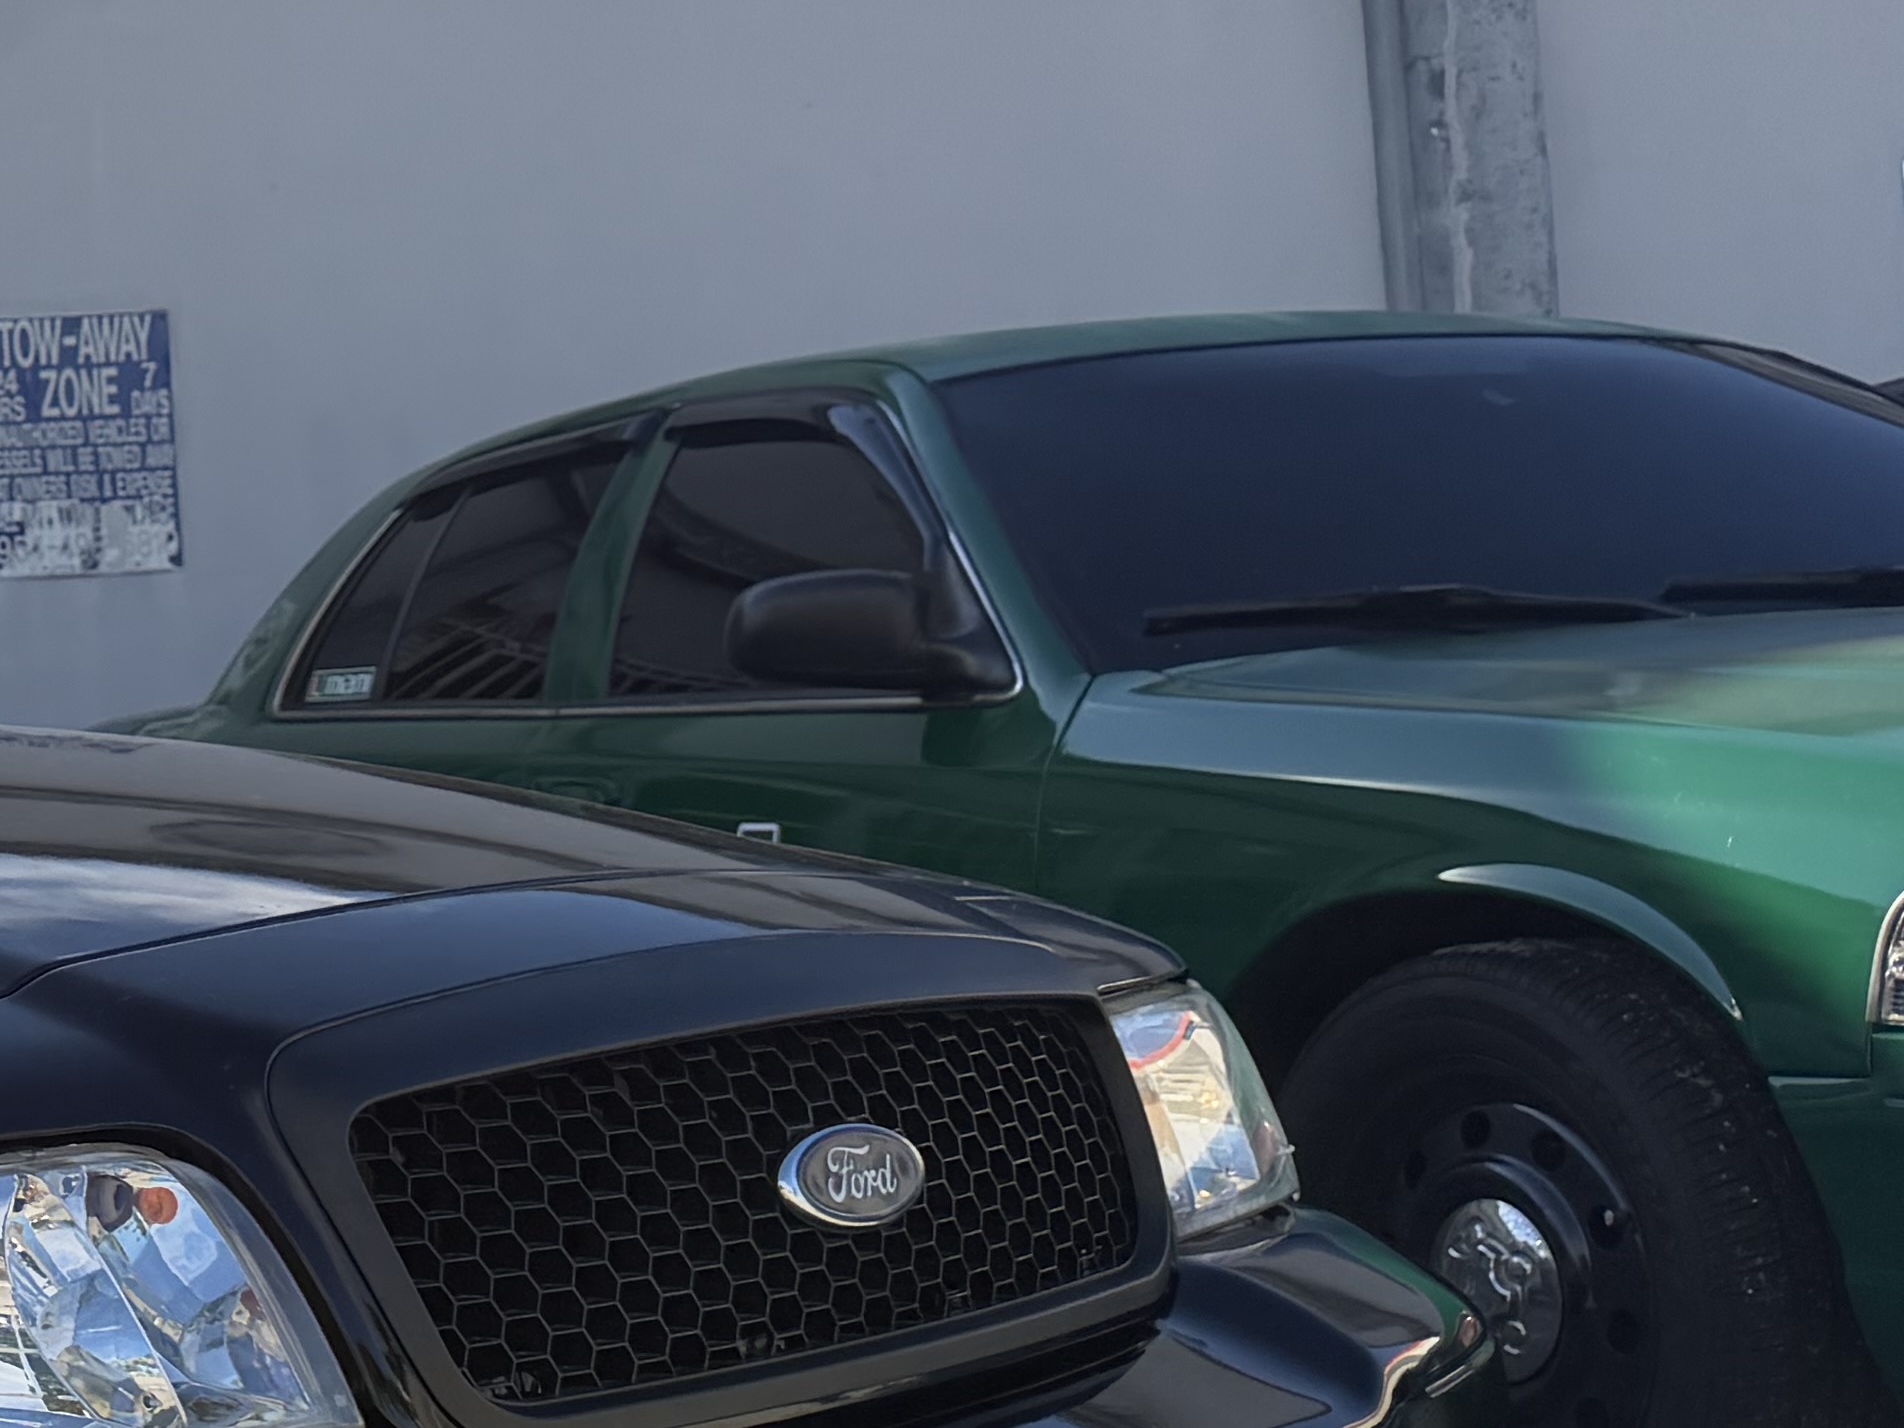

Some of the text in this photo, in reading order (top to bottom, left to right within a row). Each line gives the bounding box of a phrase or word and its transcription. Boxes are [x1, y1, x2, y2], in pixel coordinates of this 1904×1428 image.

[38, 366, 121, 419] ZONE
[140, 360, 158, 388] 7
[130, 388, 170, 416] DAYS
[827, 1144, 897, 1203] Ford
